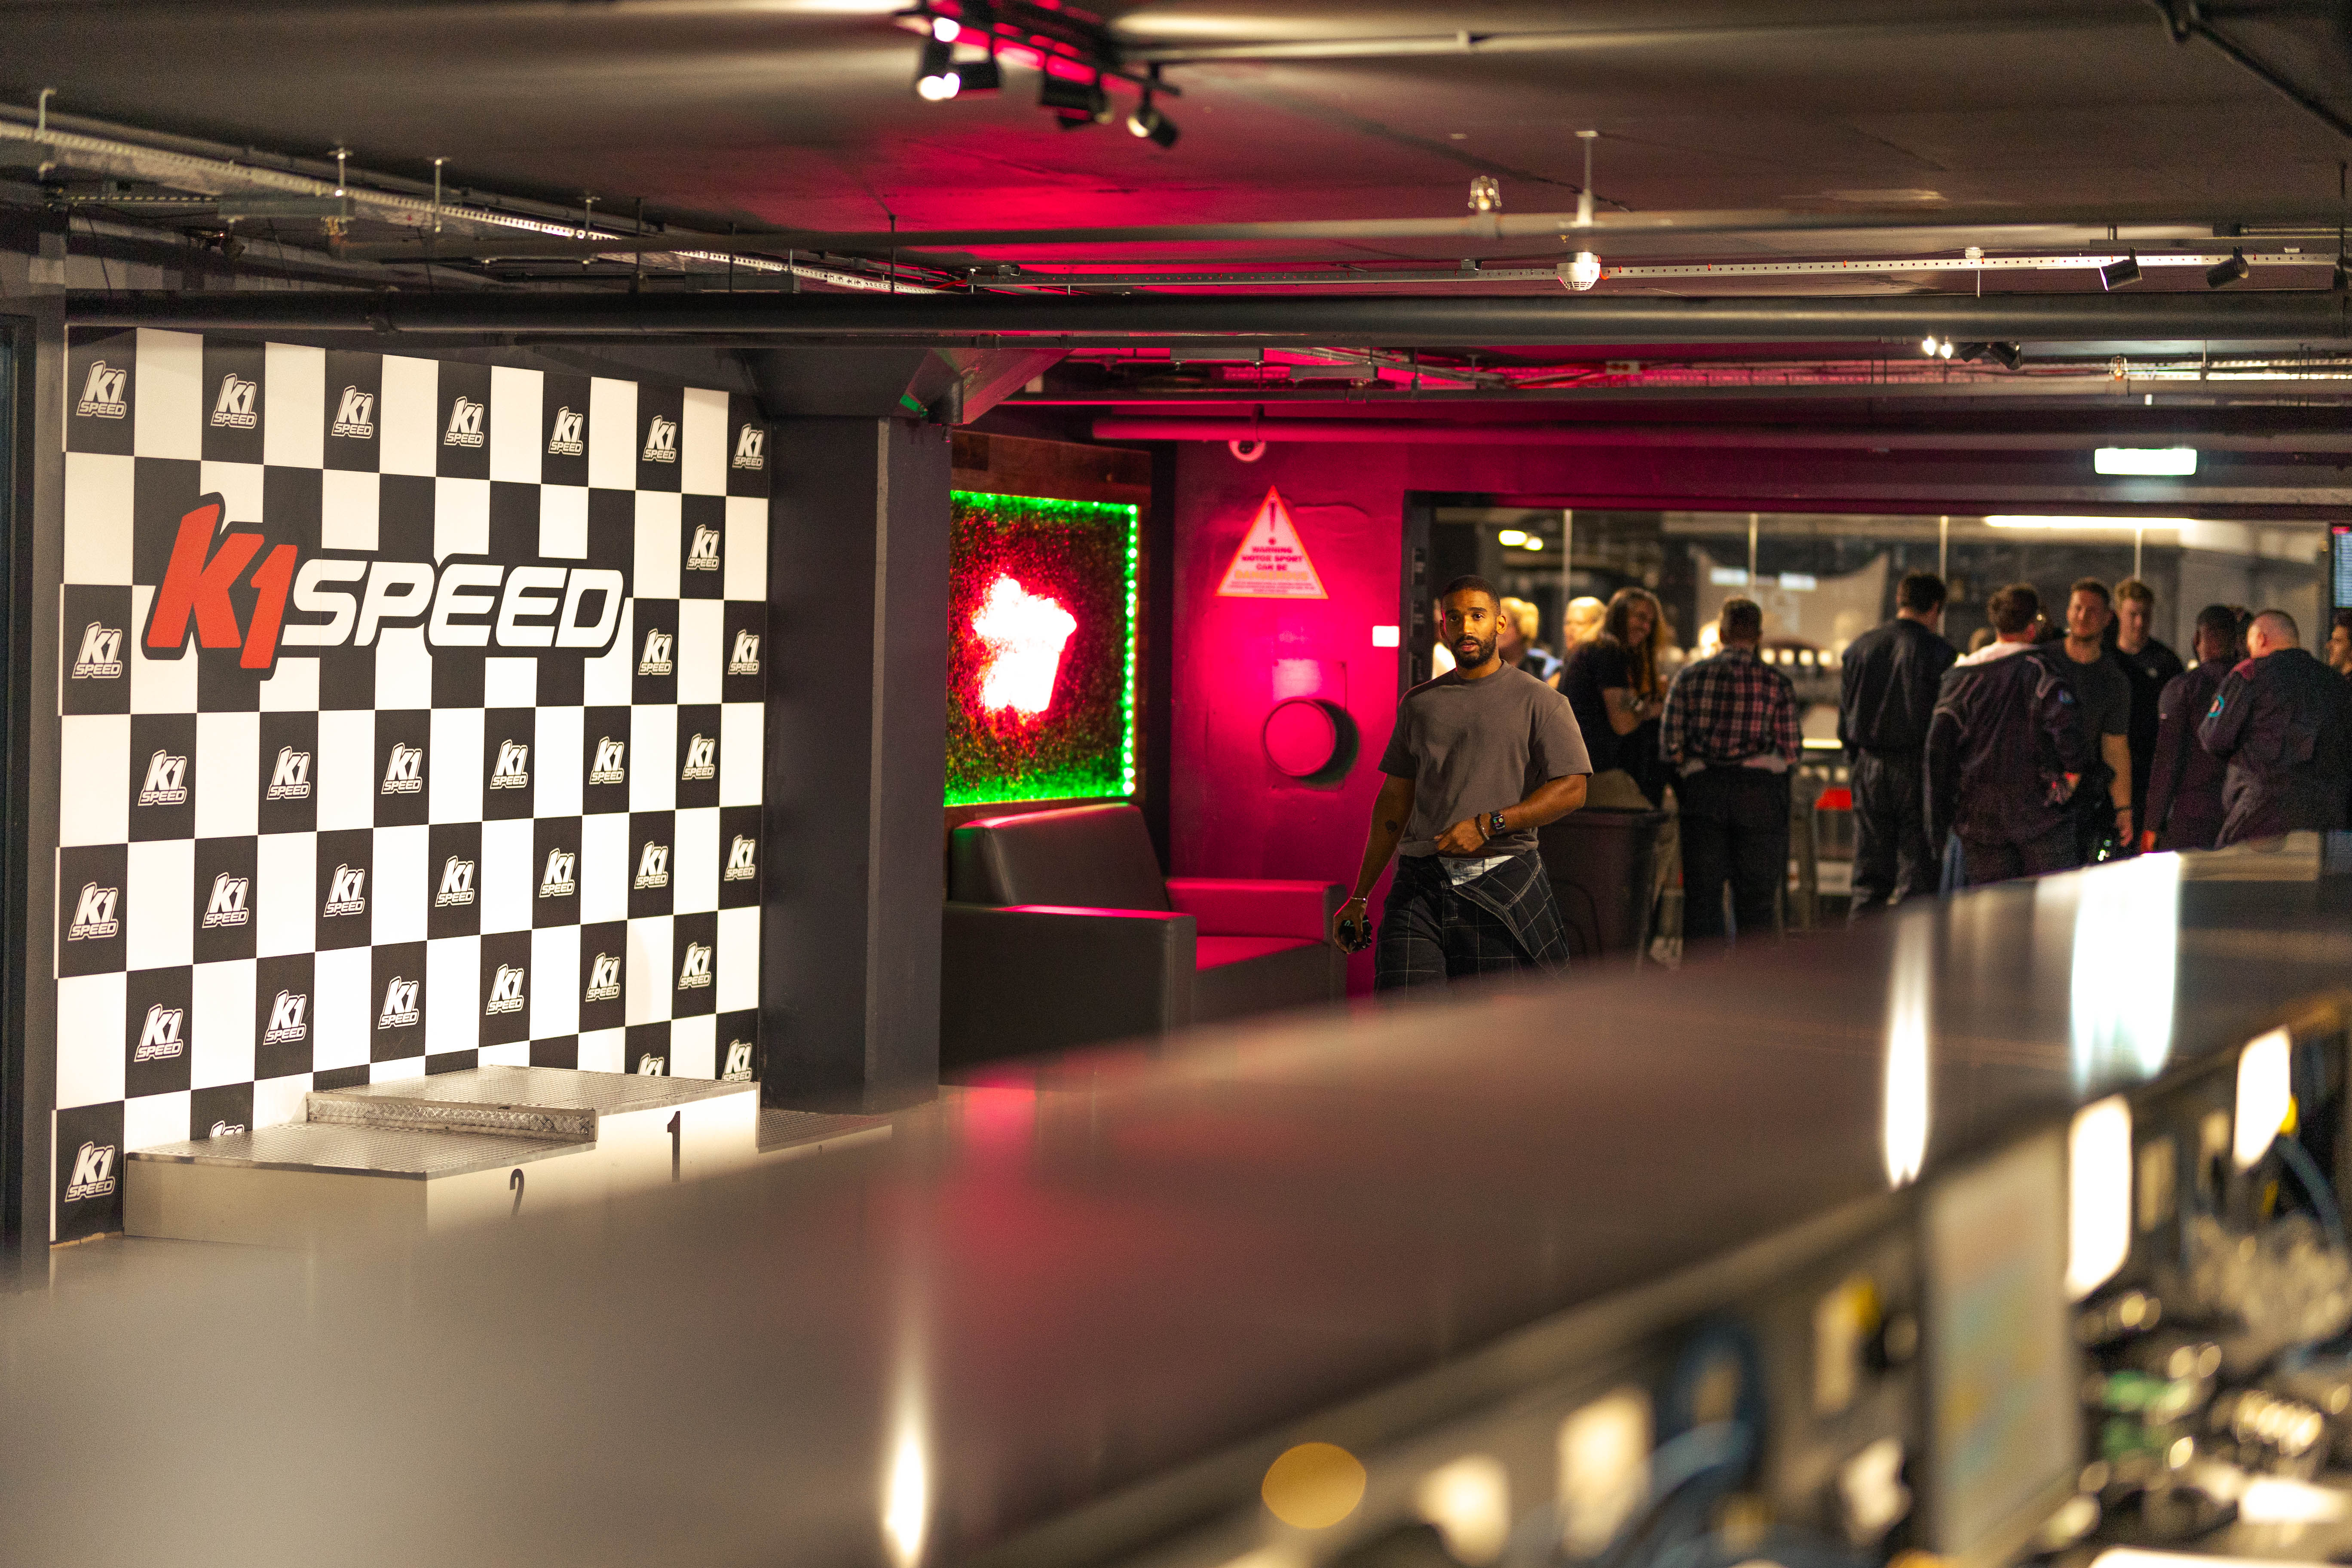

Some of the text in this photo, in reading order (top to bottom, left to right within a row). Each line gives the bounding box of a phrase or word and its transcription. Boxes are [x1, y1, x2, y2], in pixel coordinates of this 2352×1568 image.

[84, 365, 124, 403] K1
[218, 377, 254, 414] K1
[80, 402, 124, 414] SPEED
[214, 413, 254, 425] SPEED
[338, 389, 371, 424] K1
[450, 400, 482, 434] K1
[334, 424, 371, 435] SPEED
[447, 433, 482, 444] SPEED
[554, 410, 581, 442] K1
[648, 418, 675, 450] K1
[551, 442, 581, 452] SPEED
[645, 449, 675, 459] SPEED
[737, 427, 762, 457] K1
[735, 457, 762, 466] SPEED
[692, 528, 718, 558] K1
[689, 558, 718, 567] SPEED
[282, 559, 623, 647] SPEED
[80, 626, 120, 663] K1
[643, 632, 671, 662] K1
[733, 632, 758, 662] K1
[75, 665, 120, 674] SPEED
[730, 663, 758, 671] SPEED
[273, 750, 308, 785] K1
[387, 746, 420, 780] K1
[496, 743, 526, 775] K1
[594, 740, 622, 771] K1
[687, 737, 714, 768] K1
[146, 753, 184, 791] K1
[384, 781, 420, 790] SPEED
[493, 775, 526, 785] SPEED
[591, 771, 622, 781] SPEED
[684, 767, 714, 776] SPEED
[141, 791, 185, 802] SPEED
[270, 785, 308, 796] SPEED
[545, 851, 573, 884] K1
[640, 845, 666, 876] K1
[729, 838, 754, 868] K1
[330, 867, 363, 903] K1
[441, 859, 472, 893] K1
[637, 875, 666, 885] SPEED
[726, 867, 754, 877] SPEED
[209, 876, 246, 913] K1
[438, 892, 473, 903] SPEED
[542, 882, 573, 894] SPEED
[76, 886, 116, 925] K1
[205, 912, 247, 924] SPEED
[327, 901, 363, 913] SPEED
[71, 923, 116, 936] SPEED
[591, 956, 618, 988] K1
[683, 946, 710, 977] K1
[492, 967, 522, 1001] K1
[588, 986, 618, 998] SPEED
[680, 974, 710, 986] SPEED
[270, 994, 304, 1030] K1
[384, 980, 417, 1015] K1
[489, 998, 522, 1011] SPEED
[142, 1008, 181, 1046] K1
[380, 1012, 417, 1025] SPEED
[266, 1027, 304, 1041] SPEED
[138, 1043, 181, 1057] SPEED
[726, 1042, 750, 1074] K1
[723, 1071, 750, 1081] SPEED
[73, 1145, 113, 1185] K1
[68, 1180, 113, 1197] SPEED
